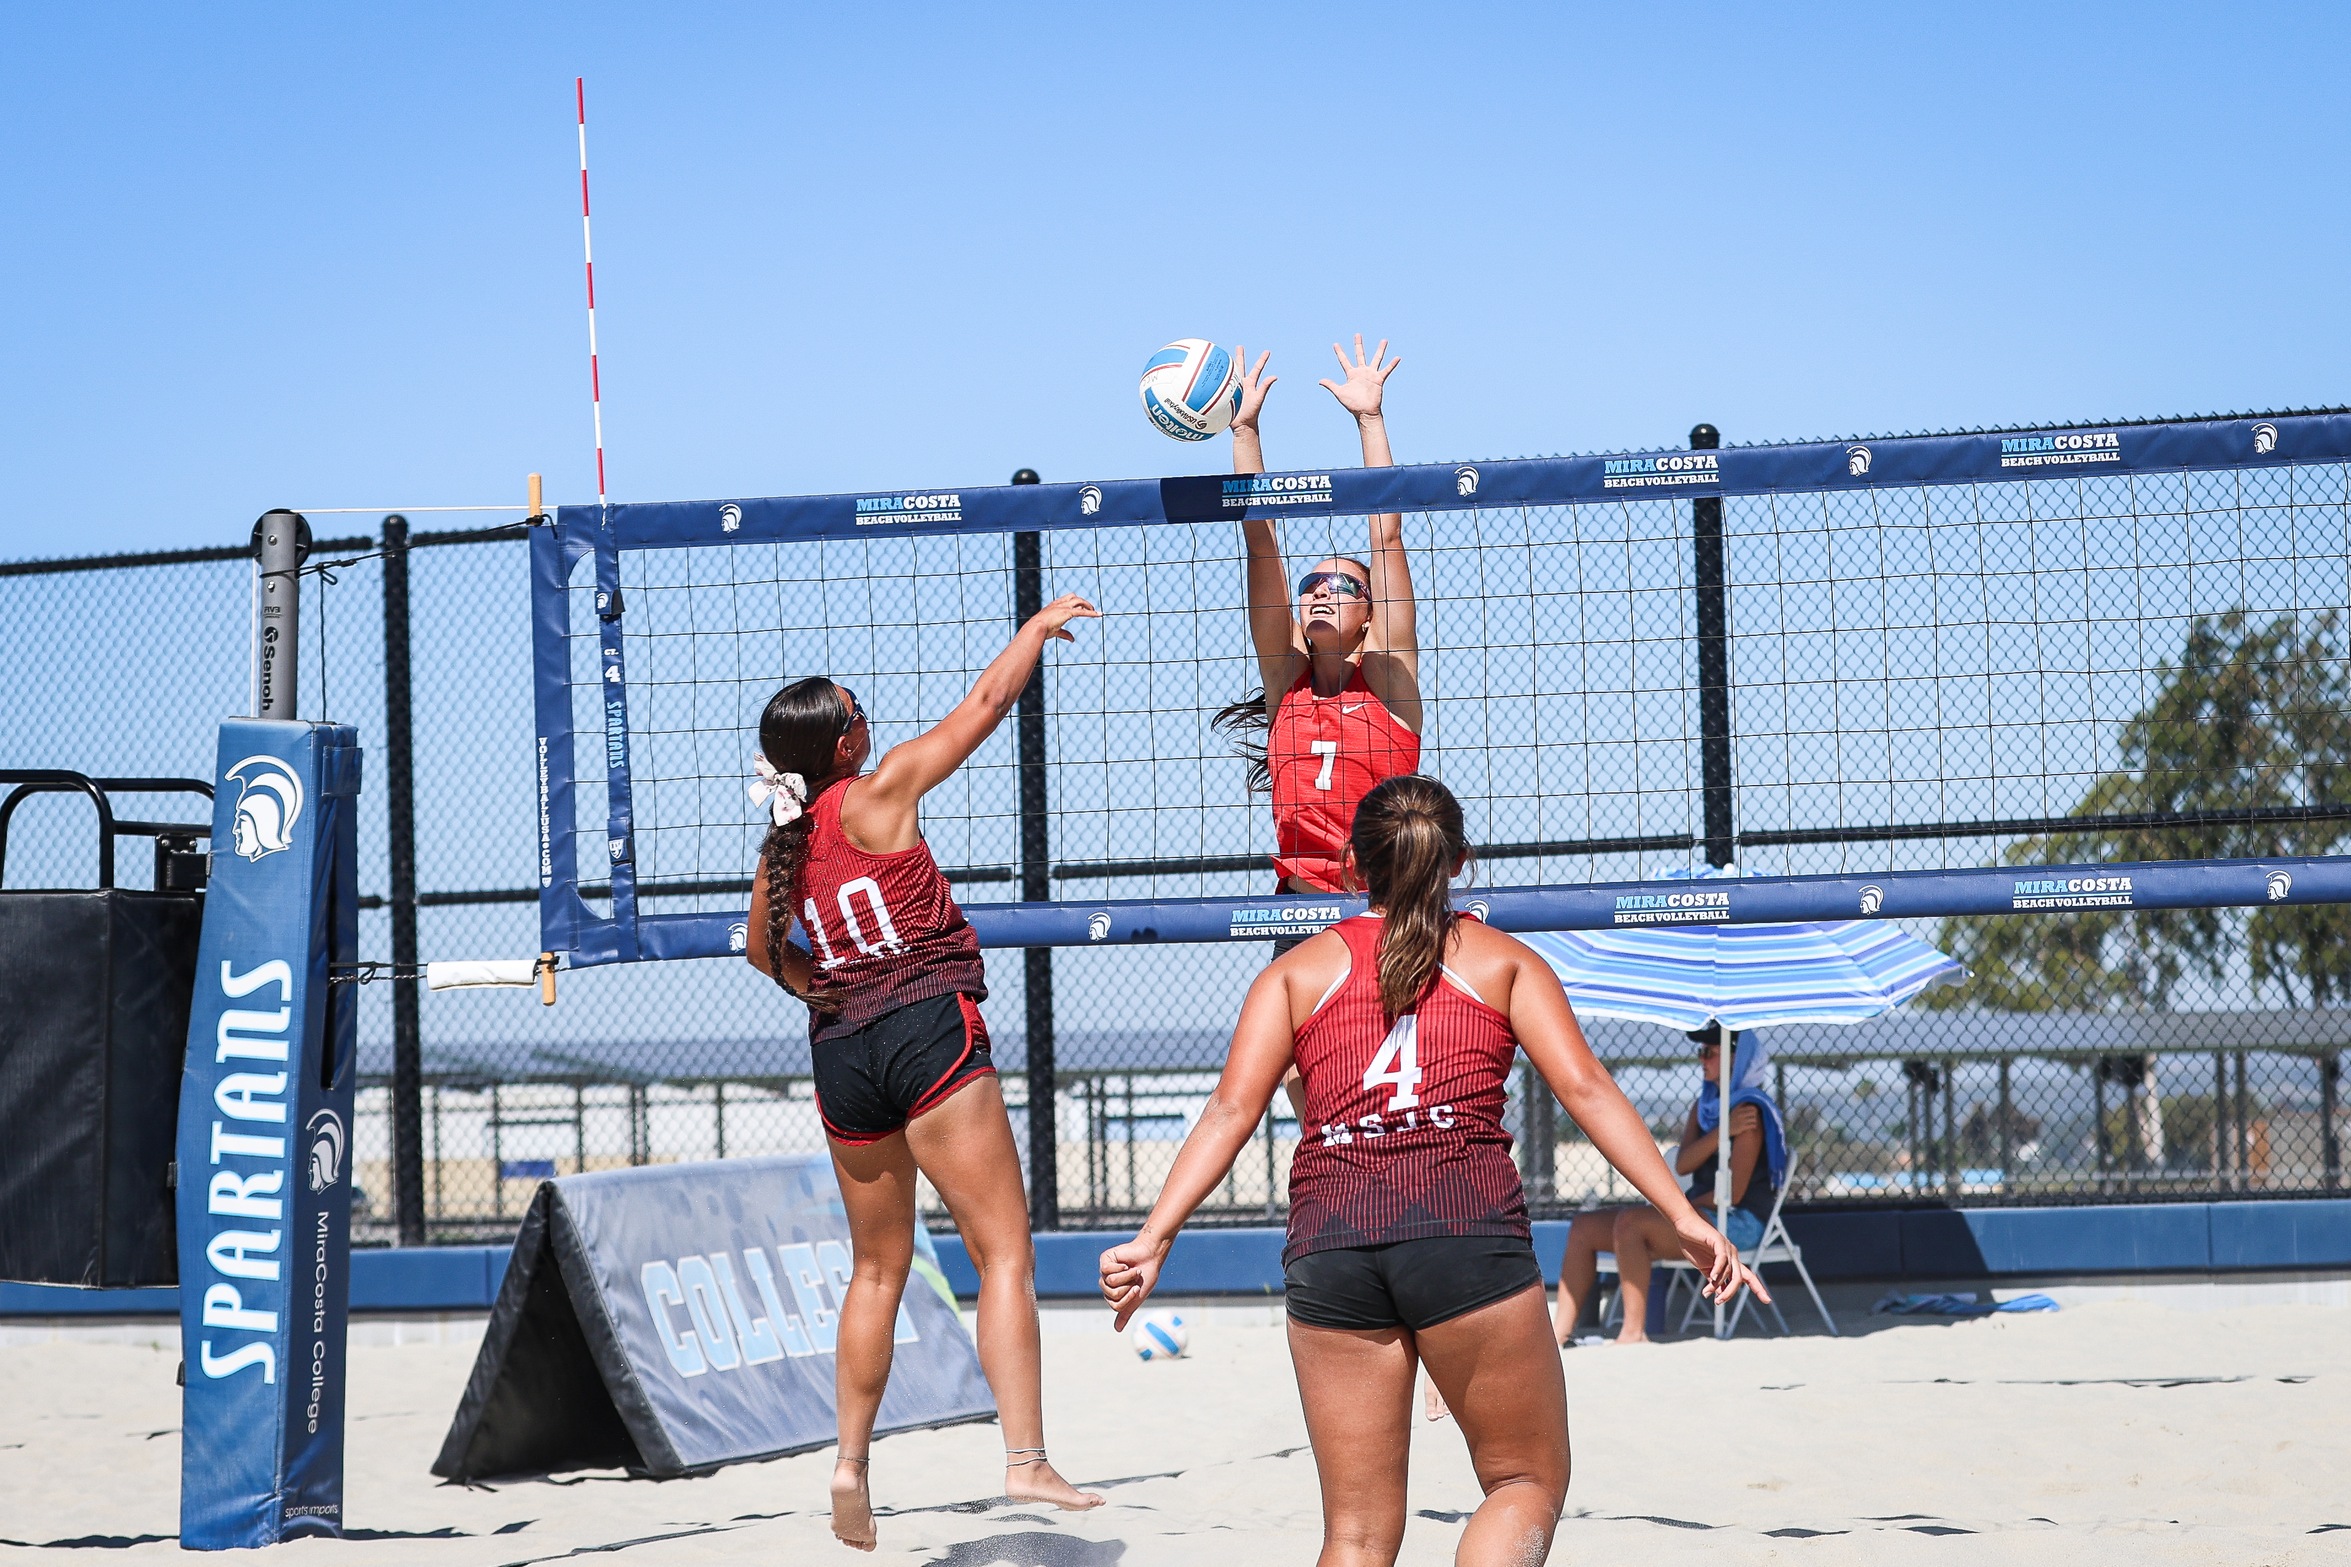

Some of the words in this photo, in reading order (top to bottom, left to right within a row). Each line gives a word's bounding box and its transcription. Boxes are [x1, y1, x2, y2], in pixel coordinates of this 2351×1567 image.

[1151, 403, 1205, 441] molten
[2001, 433, 2120, 453] MIRACOSTA
[1604, 455, 1719, 474] MIRACOSTA
[1222, 475, 1332, 493] MIRACOSTA
[856, 494, 961, 512] MIRACOSTA
[262, 645, 275, 711] Senoh
[604, 665, 621, 683] 4
[606, 701, 624, 769] SPARTANS
[1310, 740, 1337, 791] 7
[2014, 877, 2133, 894] MIRACOSTA
[1231, 906, 1342, 923] MIRACOSTA
[1616, 892, 1730, 909] MIRACOSTA
[804, 876, 903, 970] 10
[1269, 923, 1330, 935] VOLLEYB
[1362, 1014, 1422, 1112] 4
[200, 959, 292, 1385] SPARTANS
[312, 1211, 330, 1333] MiraCosta
[640, 1238, 921, 1379] COLLE
[307, 1340, 327, 1434] College
[285, 1505, 308, 1519] sports
